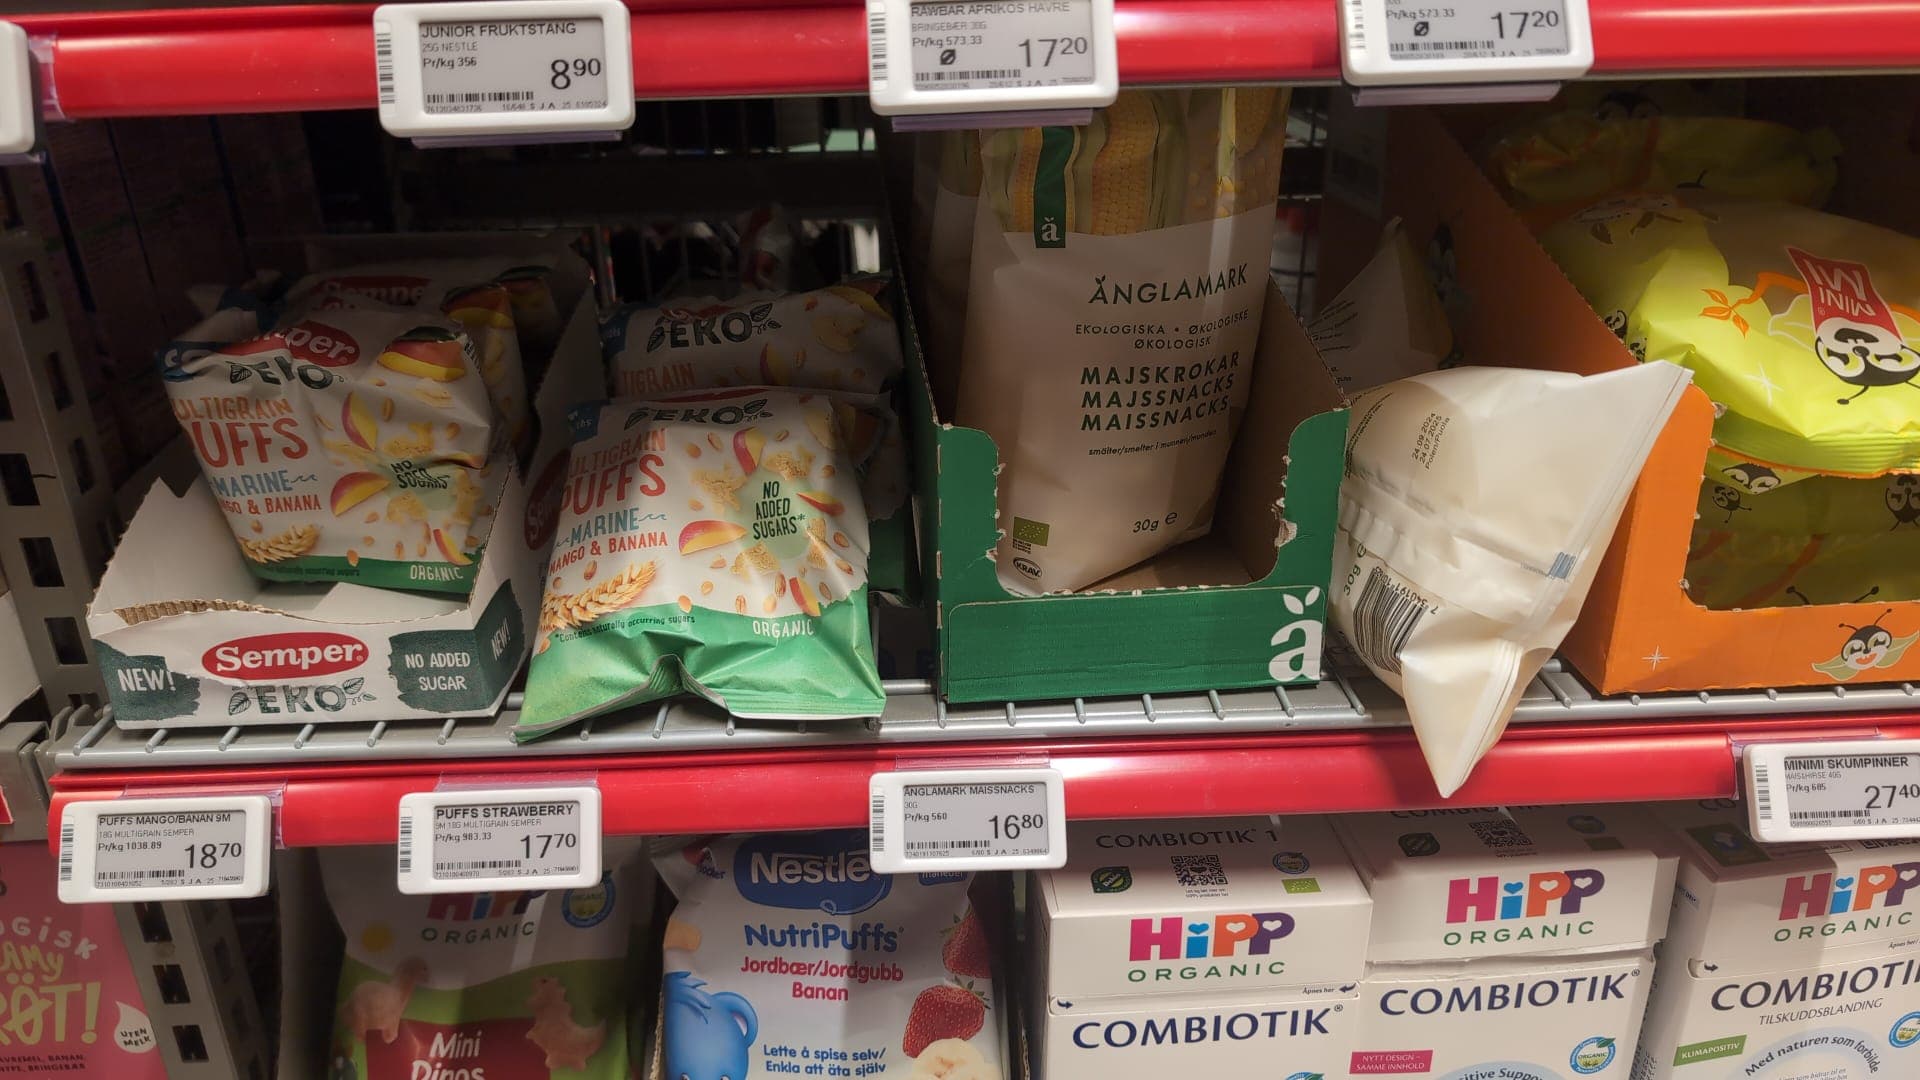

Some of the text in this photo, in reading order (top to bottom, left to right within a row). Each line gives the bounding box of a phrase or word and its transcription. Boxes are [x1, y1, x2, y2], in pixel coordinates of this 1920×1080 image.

[911, 1, 1070, 17] RAWBAR APRIKOS HAVRE
[1386, 8, 1455, 20] Pr/kg 573.33
[422, 22, 577, 38] JUNIOR FRUKTSTANG
[442, 41, 478, 51] NESTLE
[912, 35, 982, 49] Pr/kg 573.33
[423, 56, 477, 69] Pr/kg 356
[1804, 258, 1866, 300] MI
[1817, 286, 1875, 317] MINI
[1075, 309, 1249, 335] EKOLOGISKA ØKOLOGISKE
[1134, 336, 1212, 349] ØKOLOGISK
[1080, 352, 1240, 385] MAJSKROKAR
[1080, 373, 1235, 409] MAJSSNACKS
[1080, 396, 1229, 432] MAISSNACKS
[191, 418, 310, 468] UFFS
[215, 469, 292, 498] MARINE
[763, 481, 780, 498] NO
[249, 495, 322, 515] & BANANA
[755, 497, 791, 519] ADDED
[569, 507, 640, 548] MARINE
[1133, 517, 1159, 534] 30g
[590, 540, 602, 557] &
[608, 531, 668, 555] BANANA
[409, 564, 464, 582] ORGANIC
[1015, 560, 1042, 578] KRAV
[1343, 563, 1362, 597] 30g
[627, 617, 665, 628] occurring
[668, 615, 696, 625] sugars
[753, 620, 815, 639] ORGANIC
[491, 623, 511, 661] NEW!
[214, 640, 363, 672] Semper
[404, 651, 471, 669] NO ADDED
[117, 666, 176, 693] NEW!
[418, 675, 467, 692] SUGAR
[259, 685, 347, 715] EKO
[1784, 756, 1909, 770] MINIMI SKUMPINNER
[969, 784, 1035, 796] MAISSNACKS
[1786, 783, 1810, 794] Pr/kg
[99, 813, 231, 827] PUFFS MANGO/BANAN 9M
[436, 804, 574, 819] PUFFS STRAWBERRY
[904, 812, 947, 823] Pr/kg 560
[114, 828, 161, 839] MULTIGRAIN
[163, 827, 194, 838] SEMPER
[463, 819, 509, 829] MULTIGRAIN
[511, 818, 541, 827] SEMPER
[98, 841, 162, 853] Pr/kg 1038.89
[435, 832, 492, 844] Pr/kg 983.33
[1095, 829, 1252, 849] COMBIOTIK
[1446, 868, 1605, 924] HiPP
[1779, 862, 1920, 921] HiPP
[421, 921, 537, 944] ORGANIC
[1443, 920, 1595, 946] ORGANIC
[1774, 911, 1913, 943] ORGANIC
[744, 923, 899, 952] NutriPuffs
[1129, 912, 1295, 962] HiPP
[740, 956, 904, 984] Jordbær/Jordgubb
[1128, 962, 1286, 983] ORGANIC
[791, 981, 849, 1002] Banan
[1302, 986, 1319, 996] Åpnes
[1759, 998, 1884, 1026] TILSKUDDSBLANDING
[120, 1027, 148, 1039] UTEN
[123, 1034, 152, 1047] MELK
[429, 1029, 483, 1059] Mini
[763, 1044, 888, 1063] Lette å spise selv/
[1681, 1042, 1740, 1059] KLIMAPOSITIV
[1362, 1054, 1415, 1063] NYTT DESIGN
[1577, 1050, 1609, 1062] ORGANIC
[1745, 1035, 1881, 1077] Med naturen som forbilde
[410, 1060, 485, 1080] Dinos
[765, 1060, 887, 1078] Enkla att äta själv
[1356, 1062, 1425, 1071] SAMME INNHOLD
